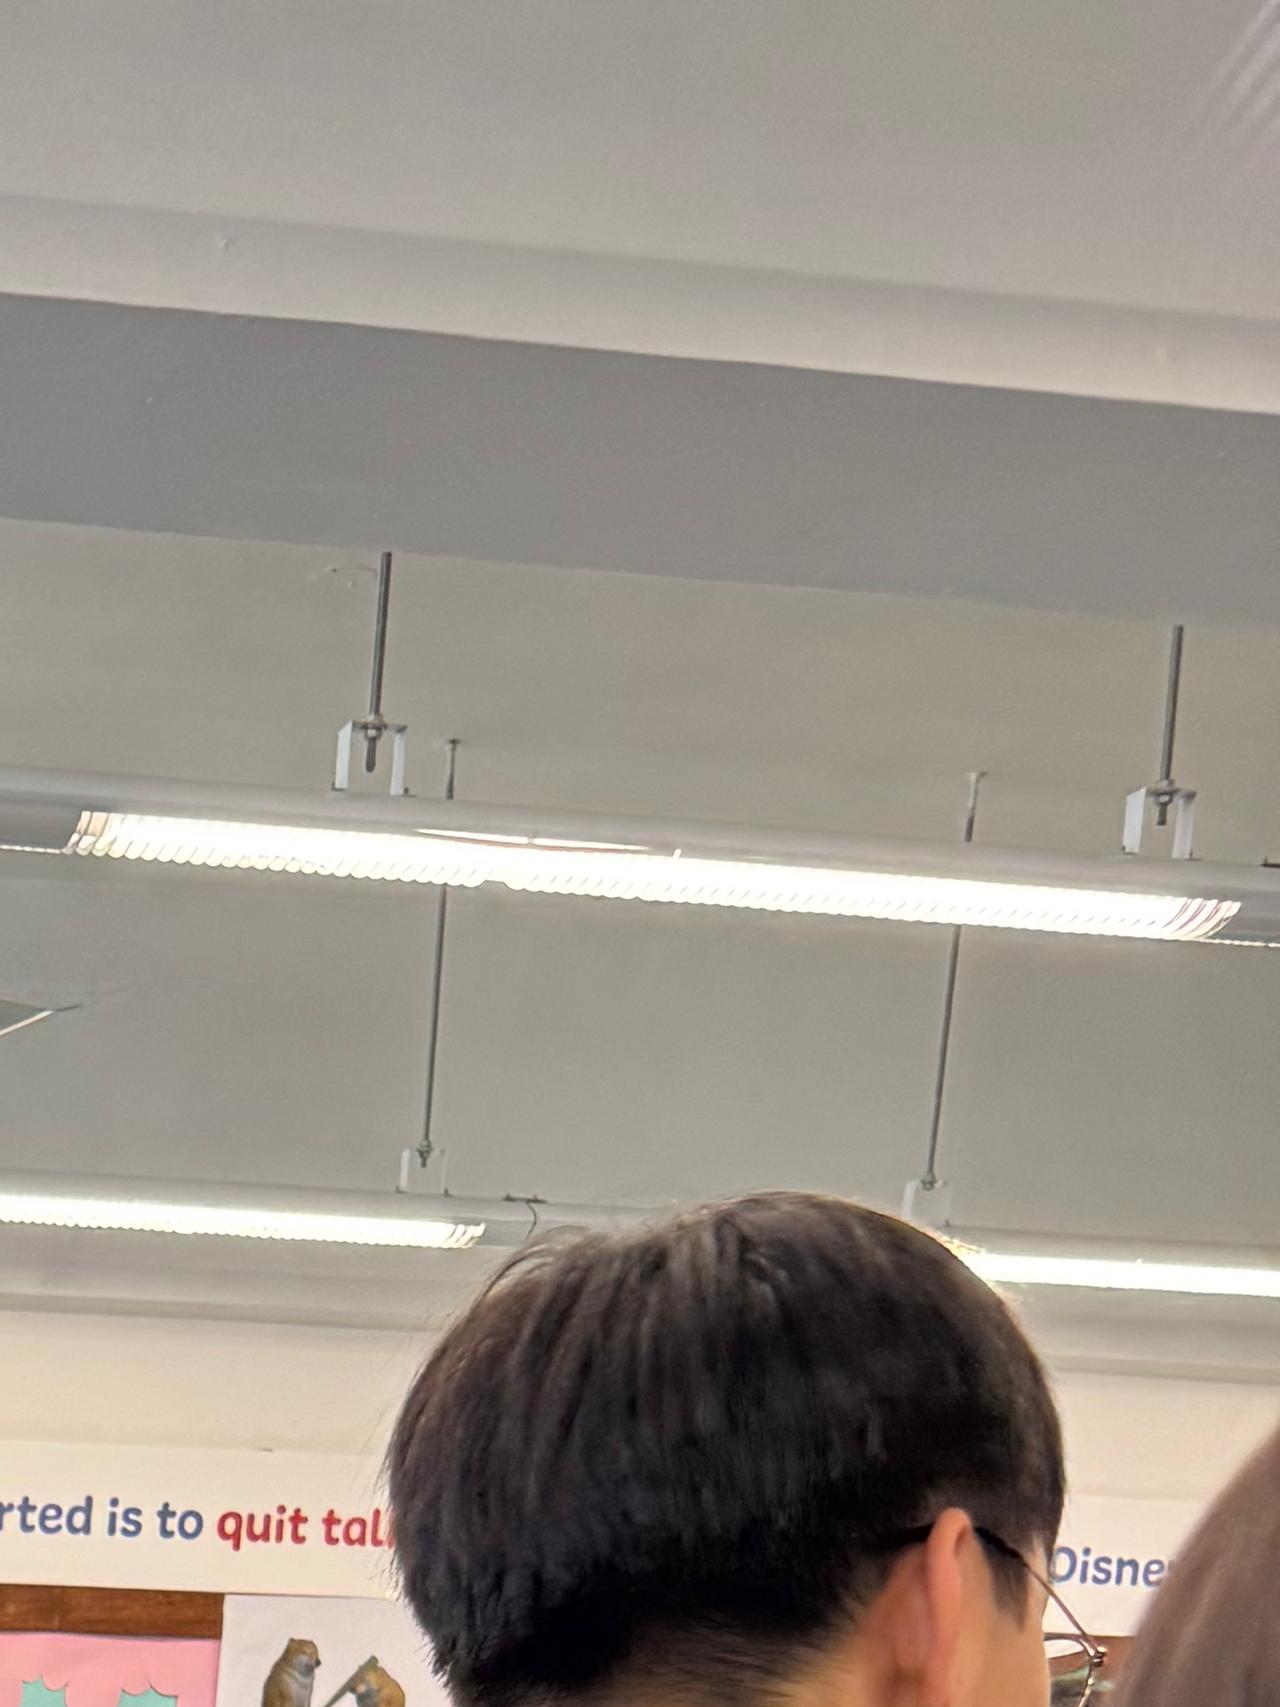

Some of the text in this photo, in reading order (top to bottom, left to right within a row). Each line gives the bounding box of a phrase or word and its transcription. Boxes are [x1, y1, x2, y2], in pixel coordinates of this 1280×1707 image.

[107, 1497, 143, 1539] is
[156, 1499, 204, 1542] to
[217, 1503, 309, 1551] quit
[322, 1506, 395, 1549] tal
[1051, 1546, 1175, 1588] Disne
